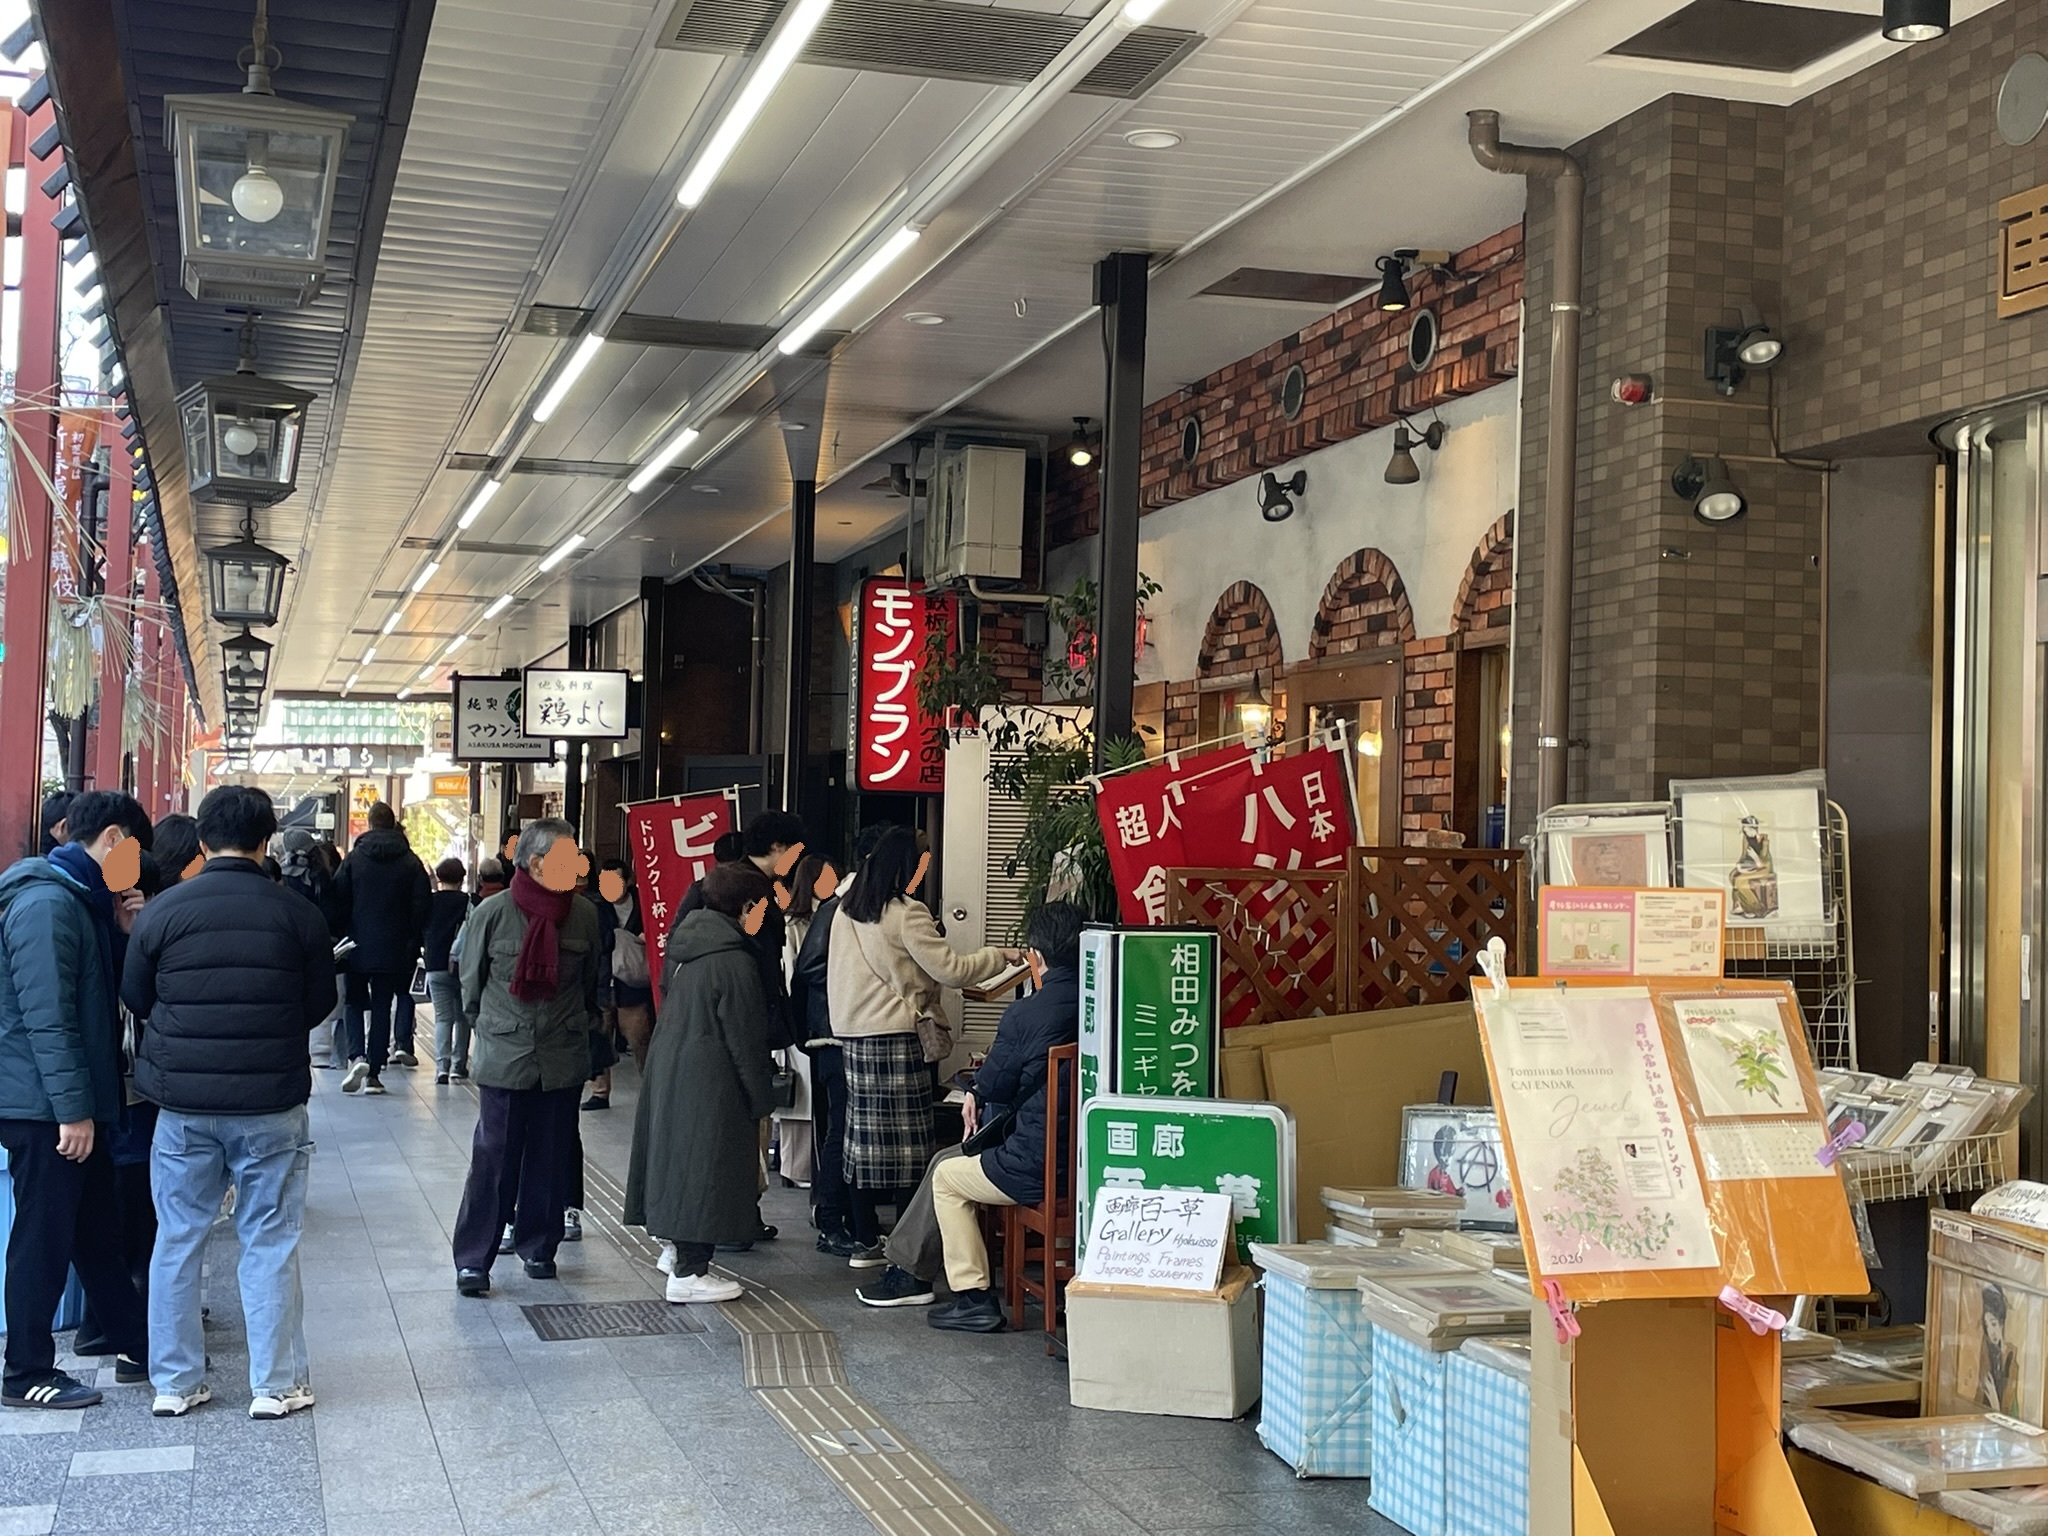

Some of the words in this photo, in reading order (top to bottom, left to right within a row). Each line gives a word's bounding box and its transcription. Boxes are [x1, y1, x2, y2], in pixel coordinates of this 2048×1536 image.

[869, 587, 916, 783] モンブラン
[468, 741, 501, 749] ASAKUSA
[502, 741, 541, 750] MOUNTAIN
[1511, 1080, 1574, 1091] CALENDAR
[1548, 1090, 1632, 1139] Jewel
[1106, 1119, 1186, 1160] 画廊
[1100, 1219, 1174, 1247] Gallery
[1095, 1261, 1144, 1279] Japanese
[1551, 1253, 1584, 1265] 2026
